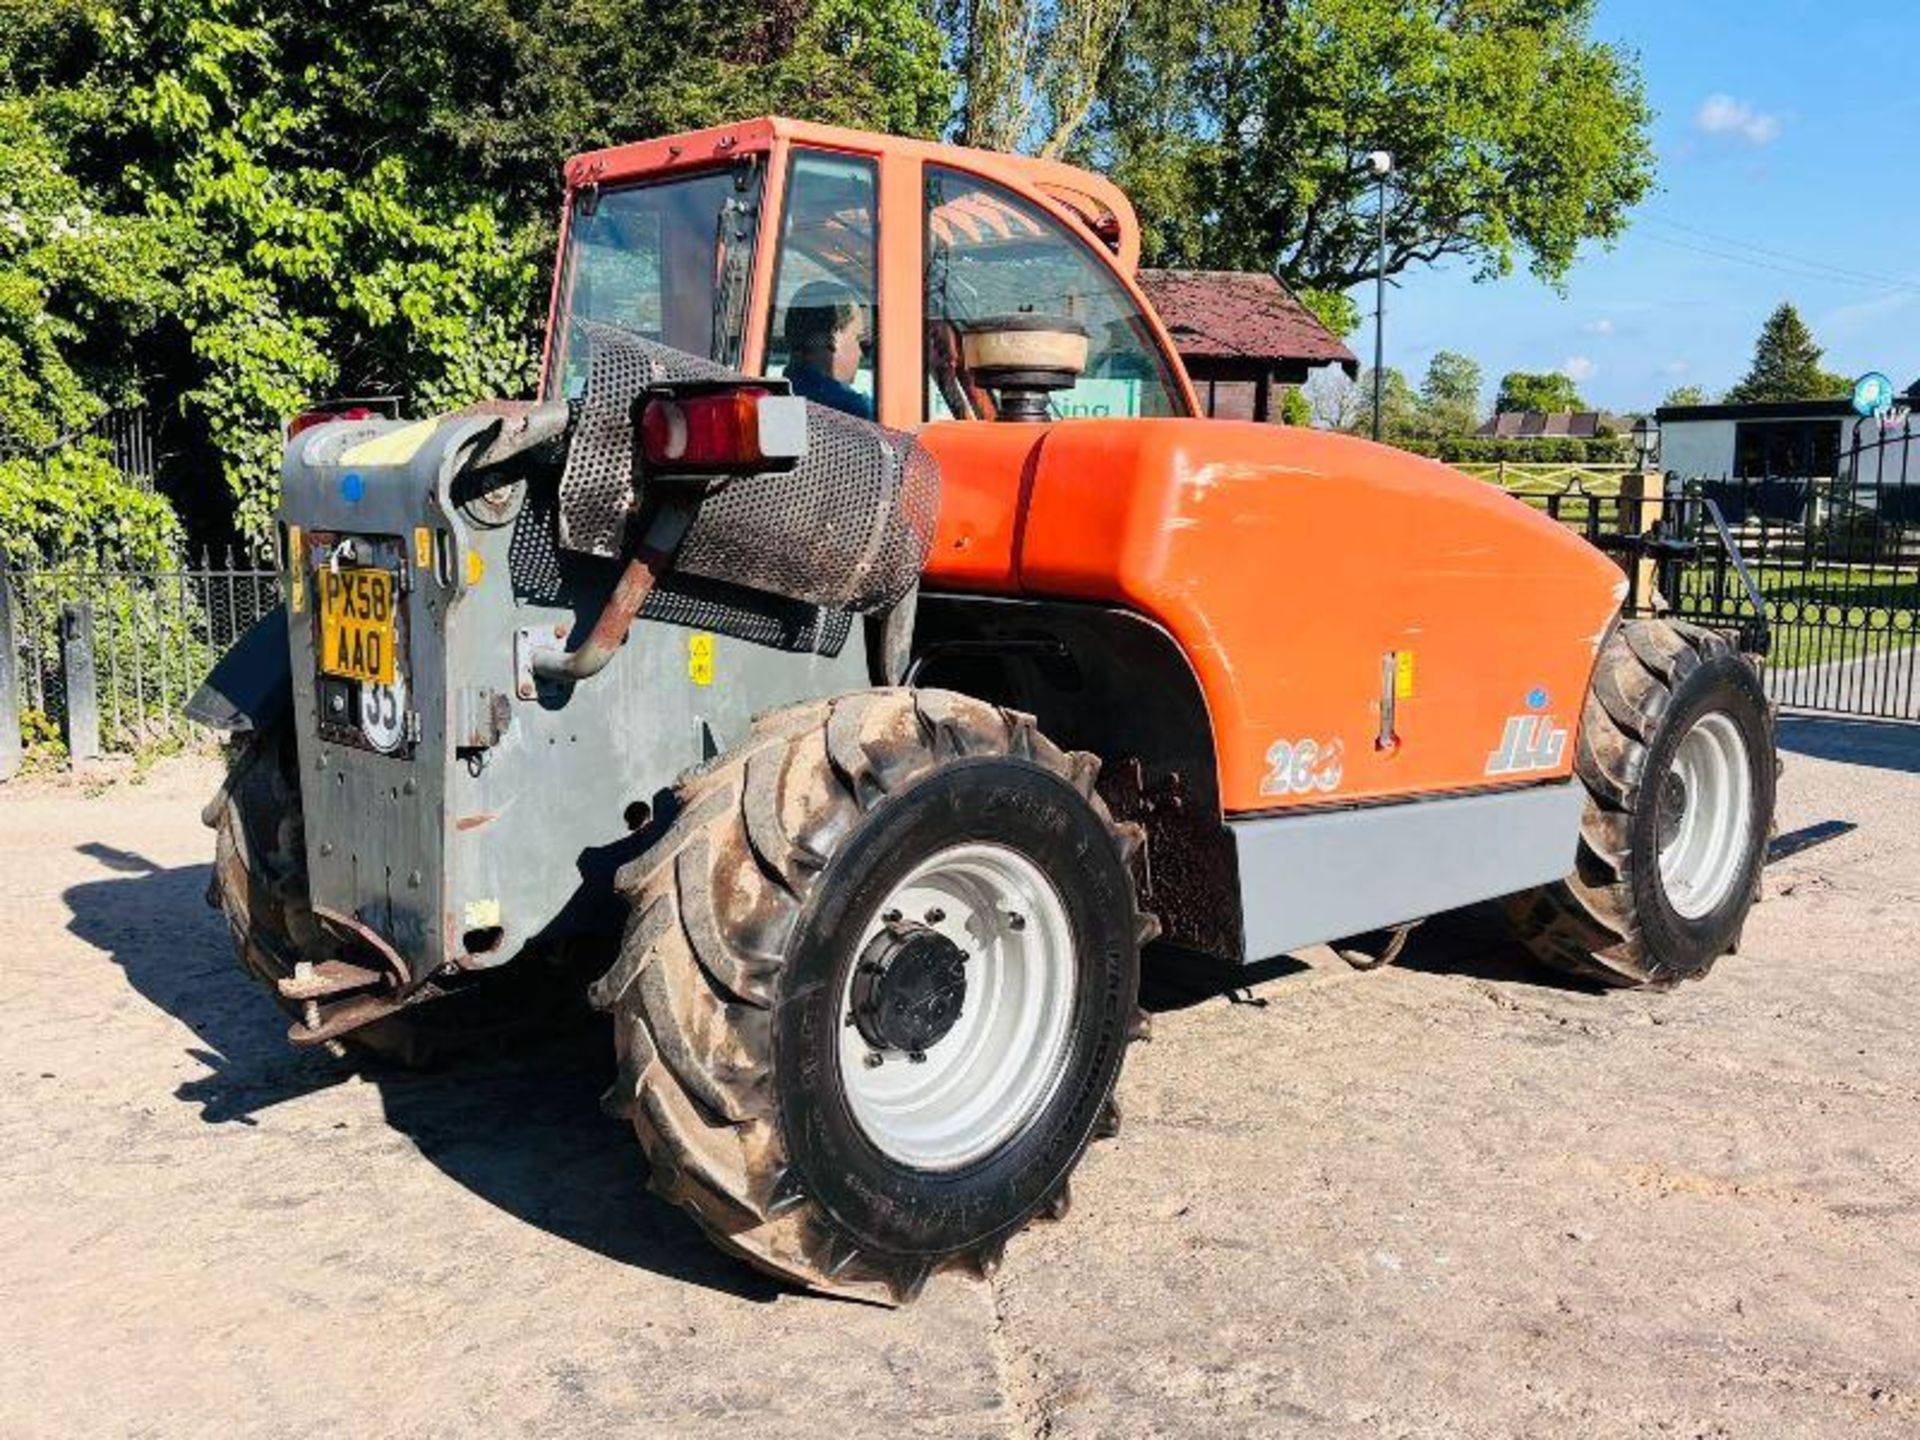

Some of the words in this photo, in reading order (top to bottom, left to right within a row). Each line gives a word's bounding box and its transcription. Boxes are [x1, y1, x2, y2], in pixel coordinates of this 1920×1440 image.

[325, 571, 387, 621] PX58
[338, 625, 381, 675] AAO
[1483, 714, 1568, 775] JLG
